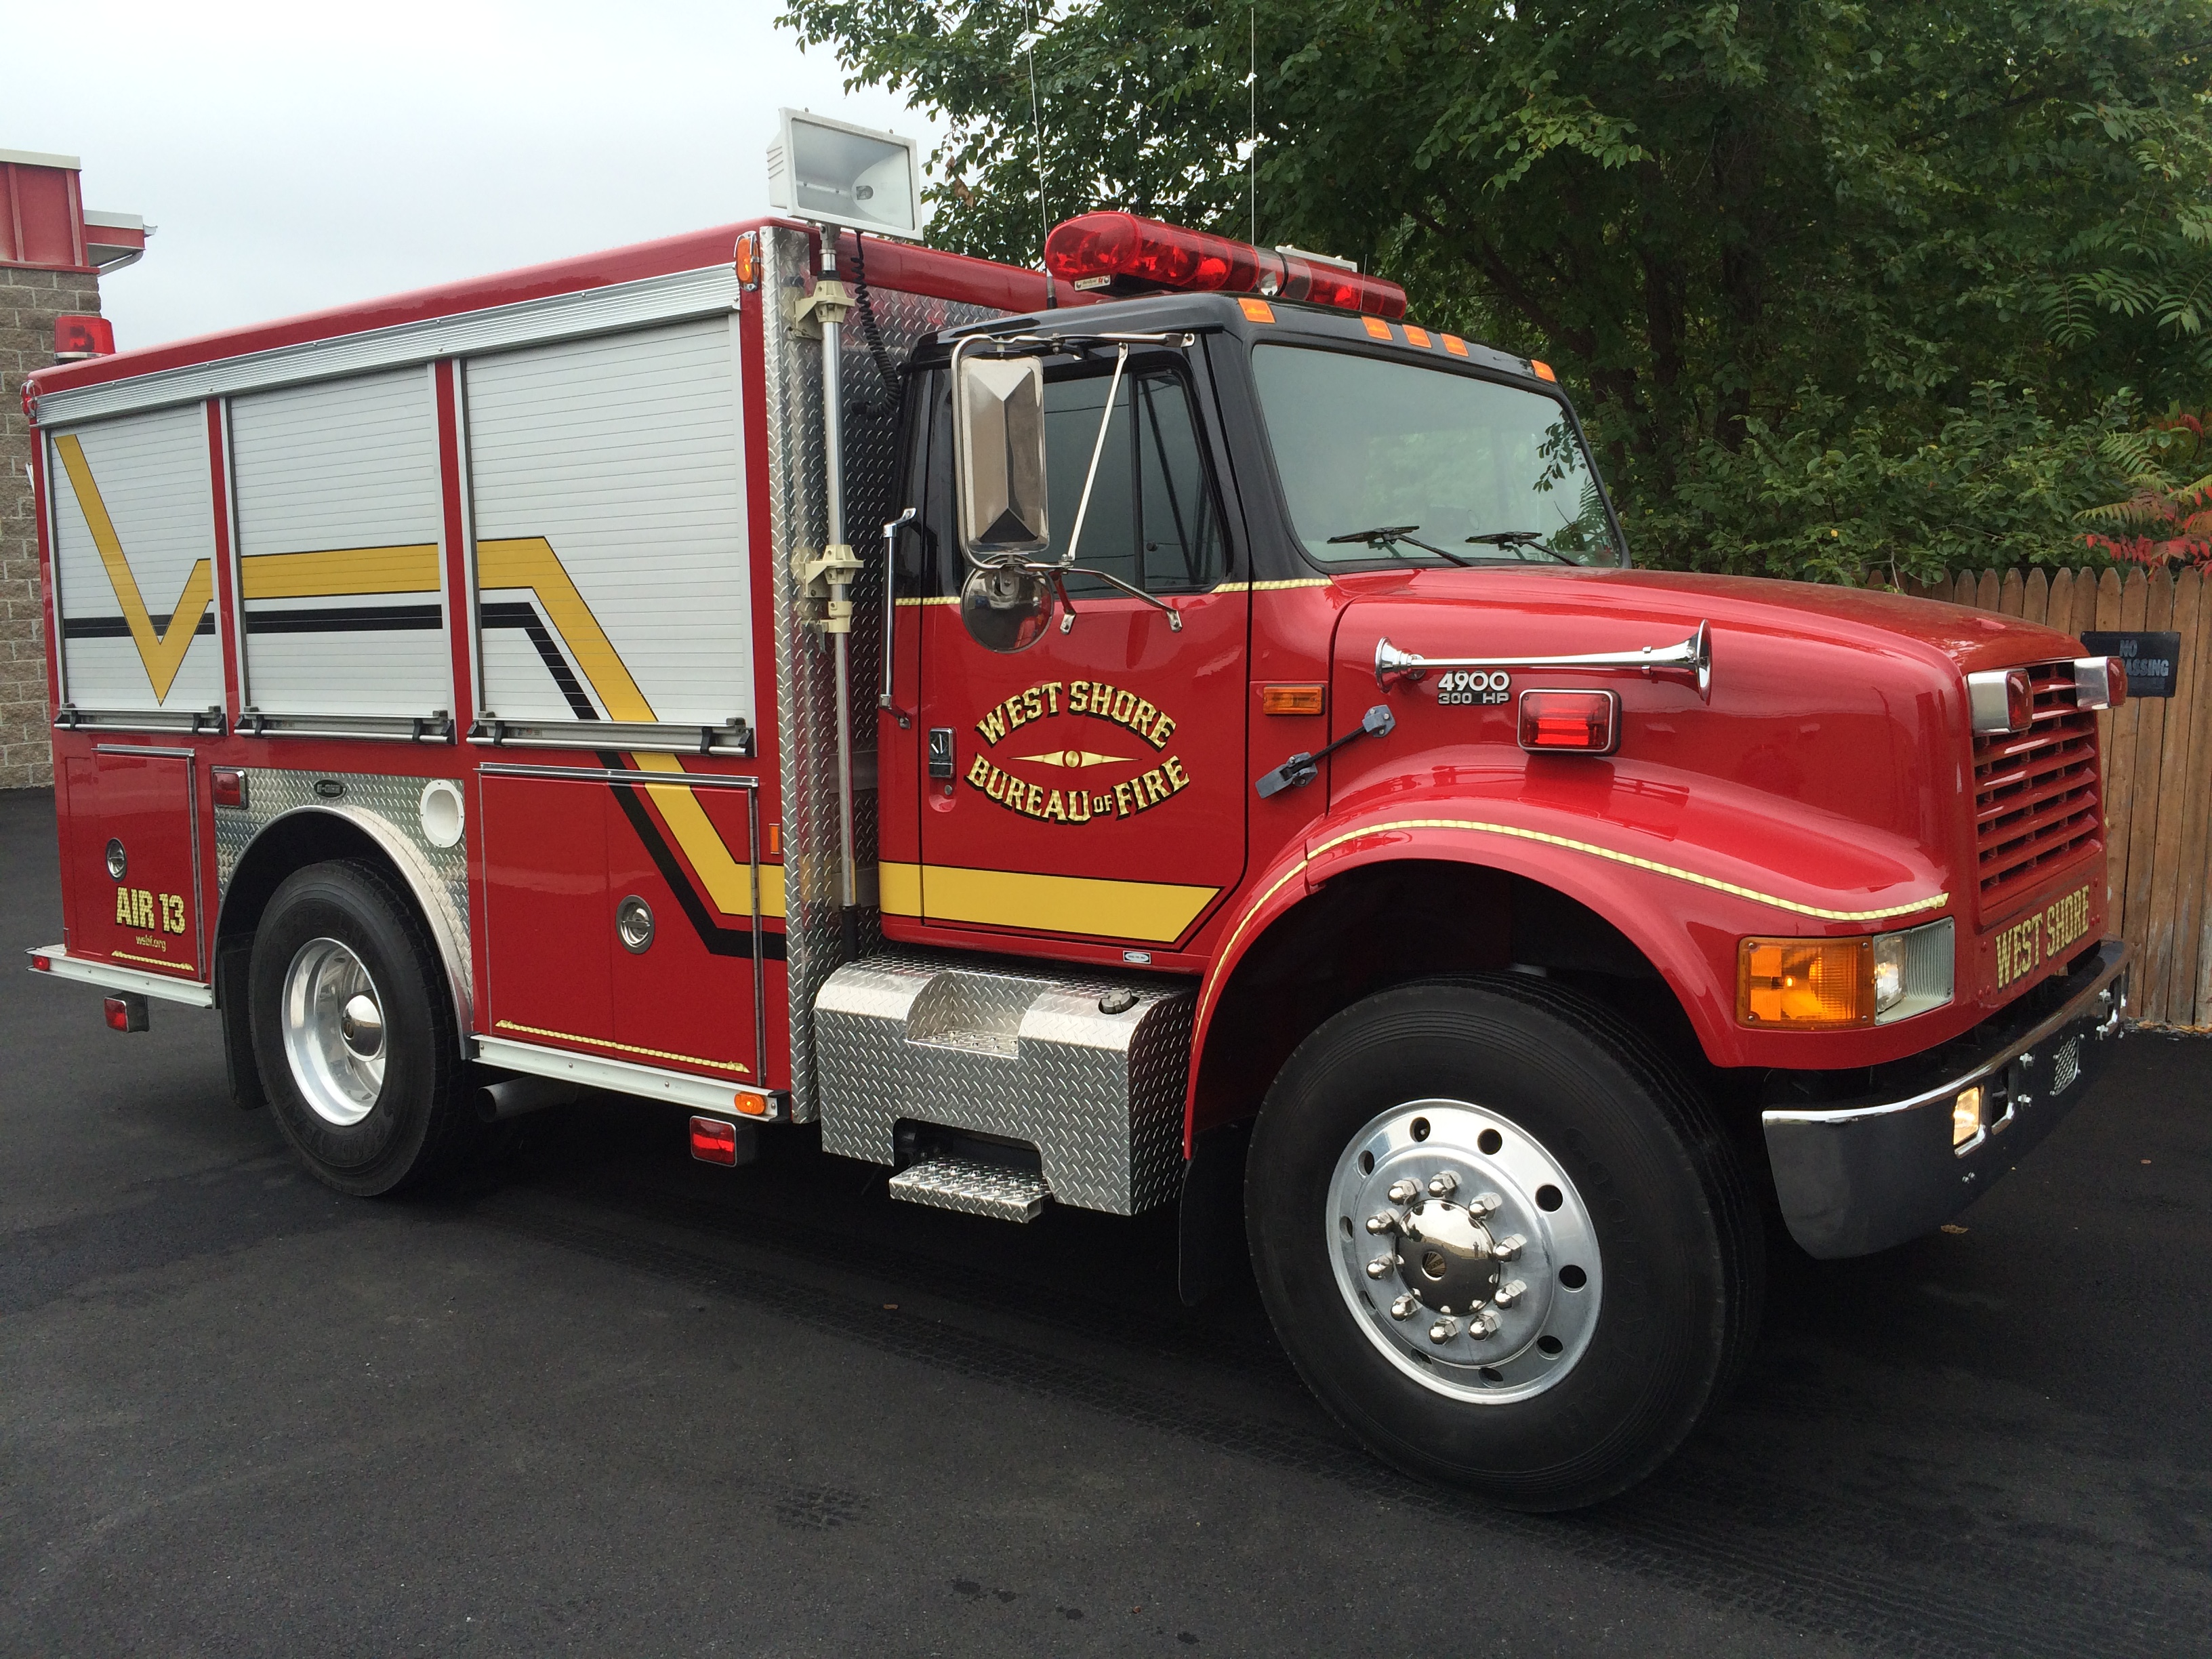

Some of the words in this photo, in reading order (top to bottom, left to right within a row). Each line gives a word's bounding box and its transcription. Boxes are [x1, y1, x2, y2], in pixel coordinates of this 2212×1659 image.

[2119, 640, 2137, 657] NO
[2122, 658, 2169, 676] ASSING
[1437, 670, 1510, 691] 4900
[1437, 693, 1473, 704] 300
[1482, 693, 1510, 704] HP
[975, 681, 1063, 746] WEST
[1067, 680, 1177, 752] SHORE
[964, 752, 1092, 824] BUREAU
[1092, 794, 1113, 816] OF
[1111, 755, 1190, 819] FIRE
[115, 886, 155, 930] AIR
[159, 893, 186, 935] 13
[136, 935, 167, 952] wsbf.org
[1995, 912, 2043, 991] WEST
[2047, 884, 2089, 959] SHORE
